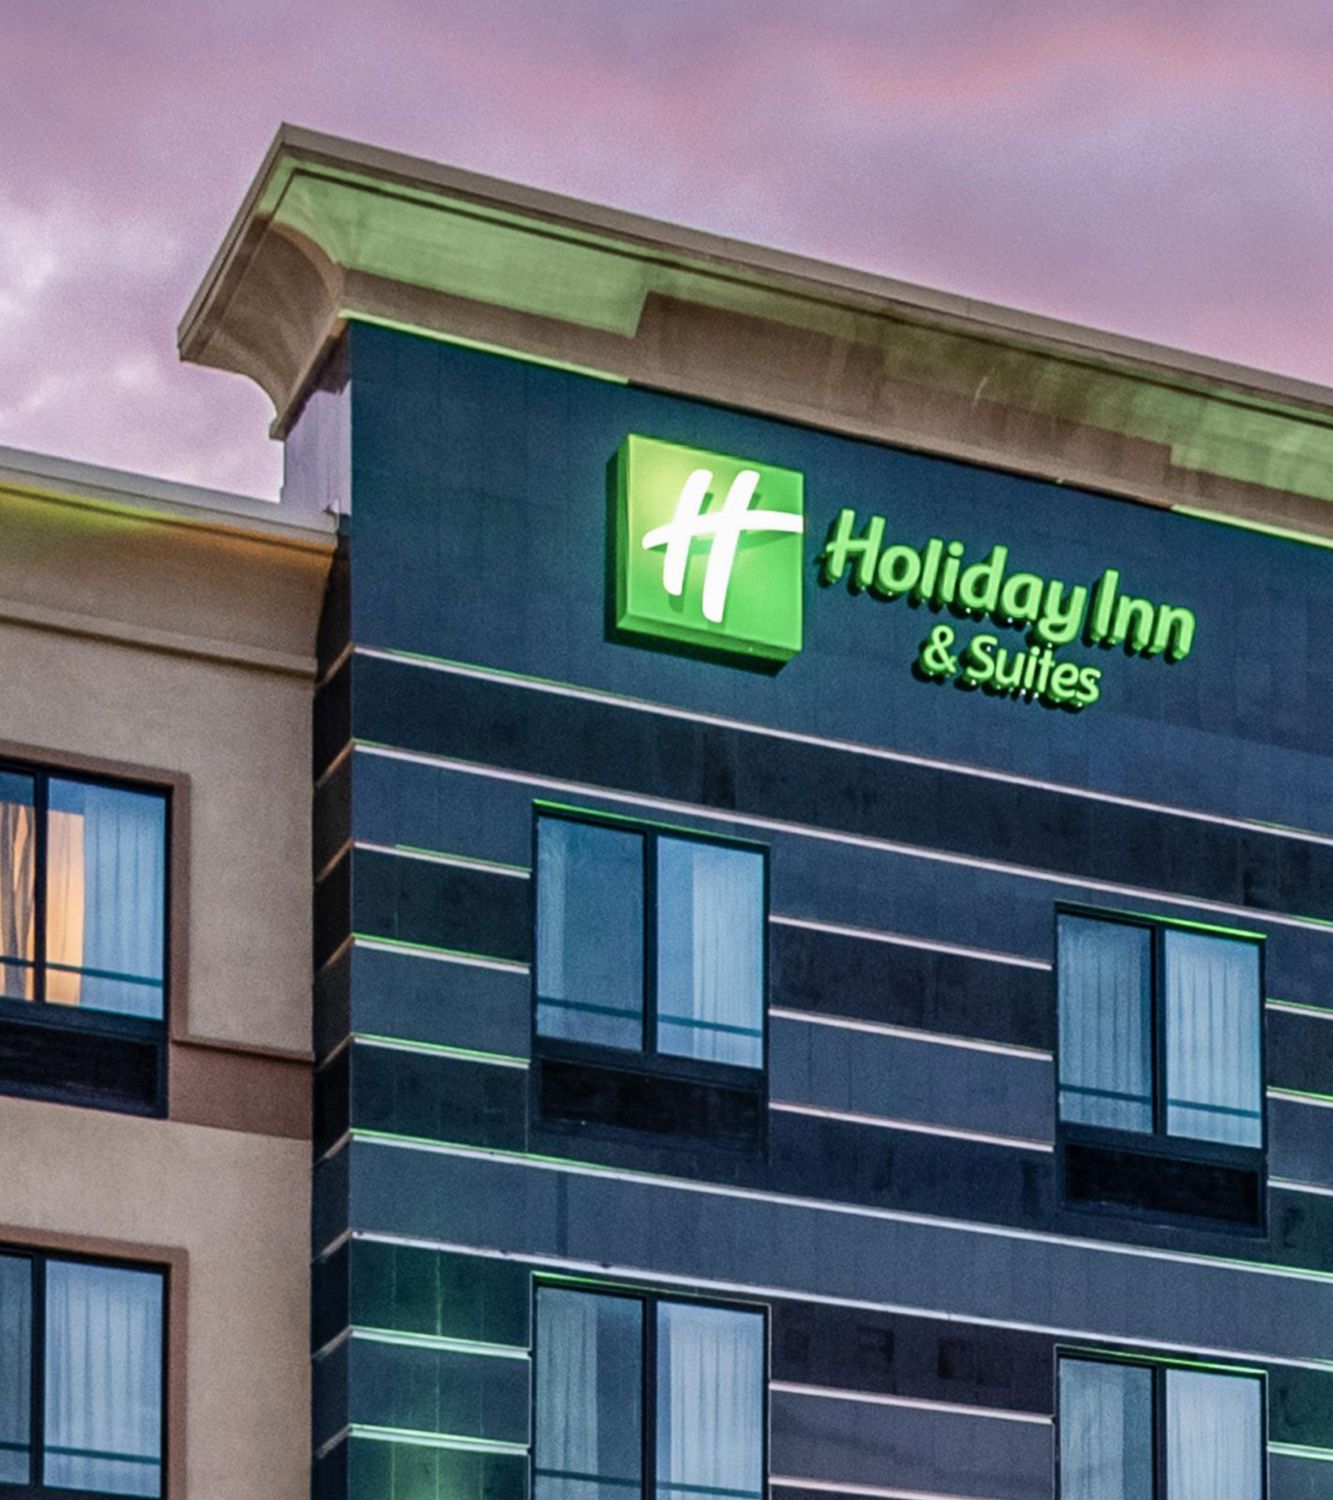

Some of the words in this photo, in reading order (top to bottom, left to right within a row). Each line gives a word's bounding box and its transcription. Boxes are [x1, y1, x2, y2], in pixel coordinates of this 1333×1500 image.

[824, 508, 1088, 645] Holiday
[1090, 568, 1197, 659] Inn
[920, 624, 957, 676] &
[964, 635, 1102, 706] Suites
